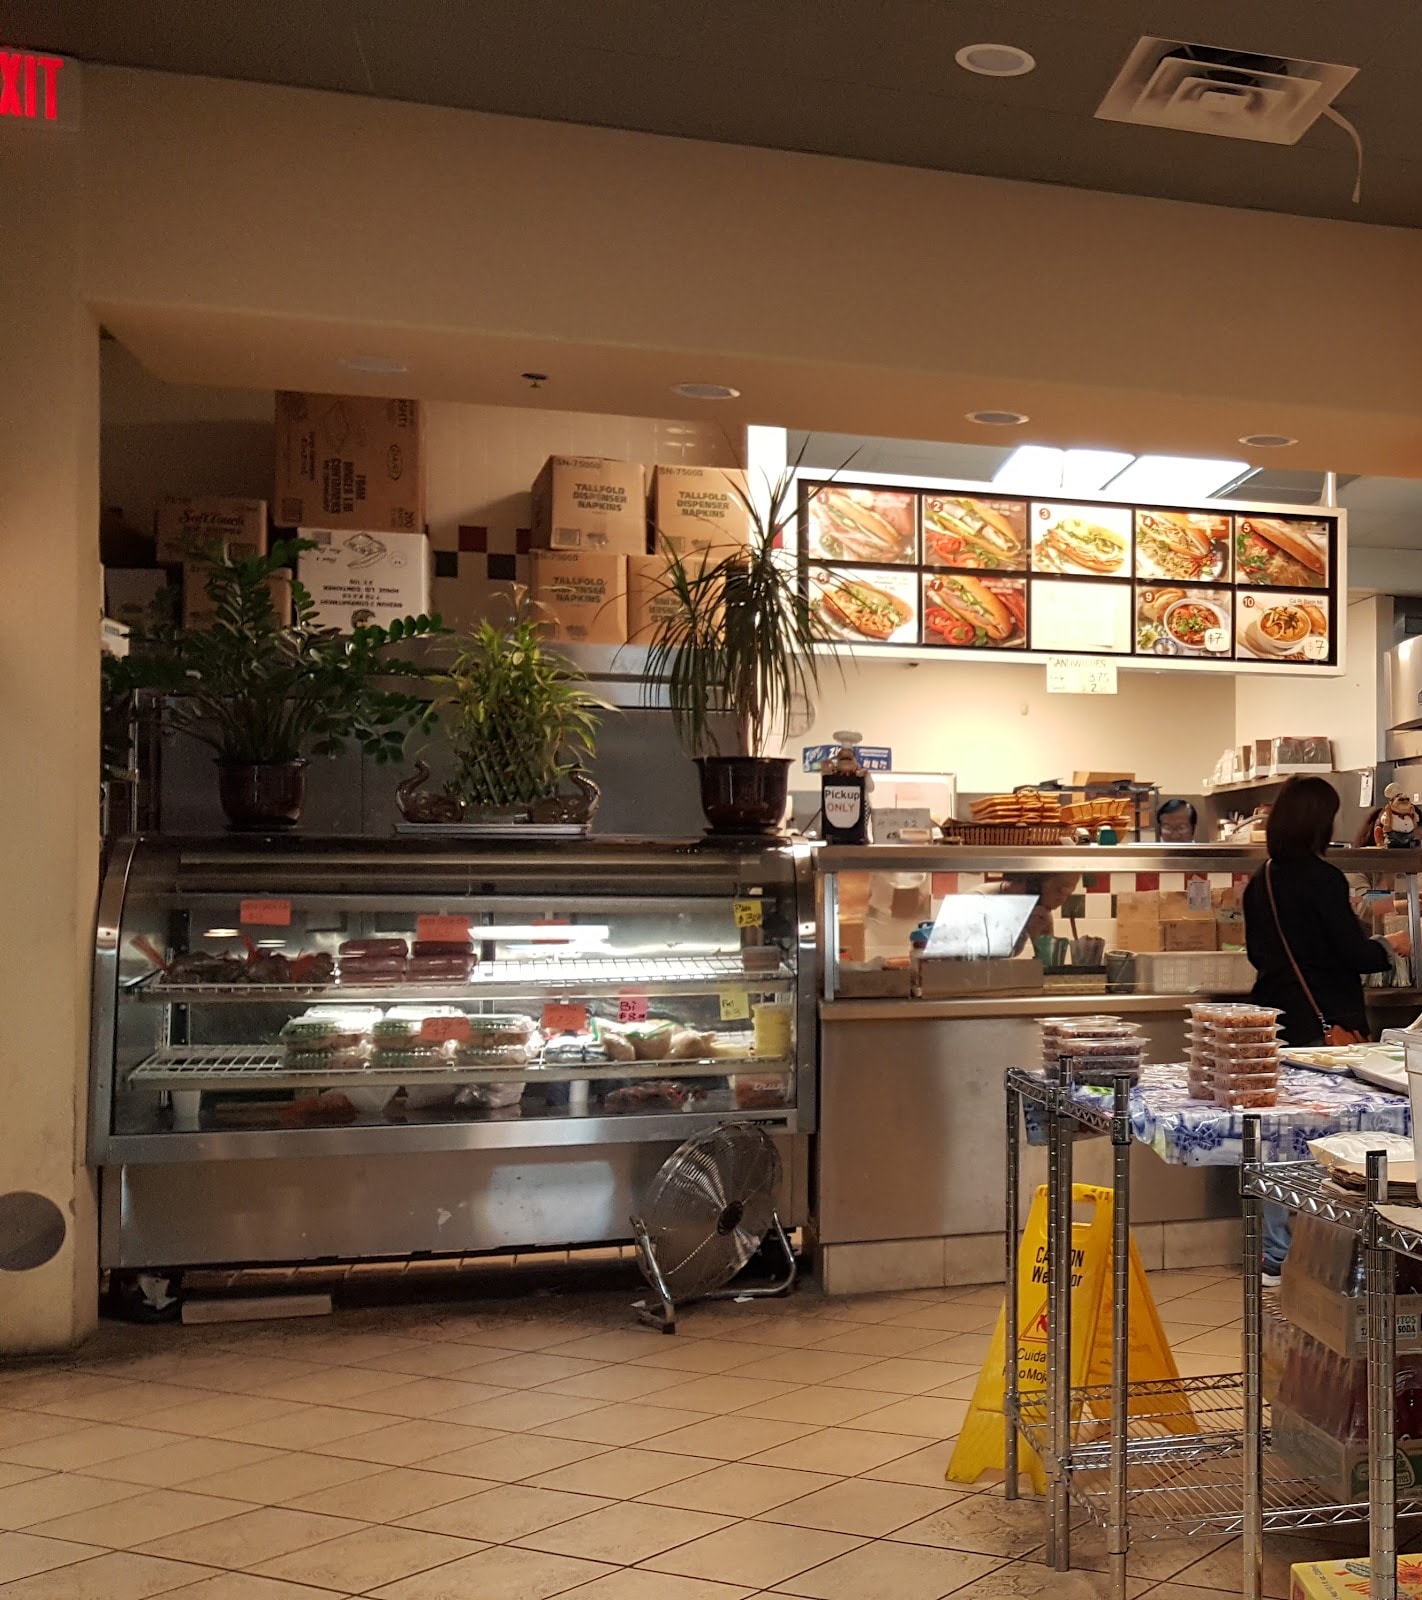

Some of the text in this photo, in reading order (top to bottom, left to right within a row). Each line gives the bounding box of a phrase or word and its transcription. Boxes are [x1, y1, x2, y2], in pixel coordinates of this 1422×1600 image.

[0, 51, 64, 120] XIT
[575, 483, 625, 494] TALLFOLD
[573, 492, 627, 503] DISPENSER
[679, 491, 727, 500] TALLFOLD
[577, 501, 622, 512] NAPKINS
[676, 500, 729, 510] DISPENSER
[681, 509, 725, 518] NAPKINS
[1207, 632, 1224, 644] $7
[825, 789, 860, 801] Pickup
[826, 803, 855, 813] ONLY
[1035, 1246, 1085, 1267] CAON
[1397, 1325, 1416, 1334] SODA
[1017, 1347, 1047, 1361] Cuida
[1027, 1368, 1048, 1383] Moja
